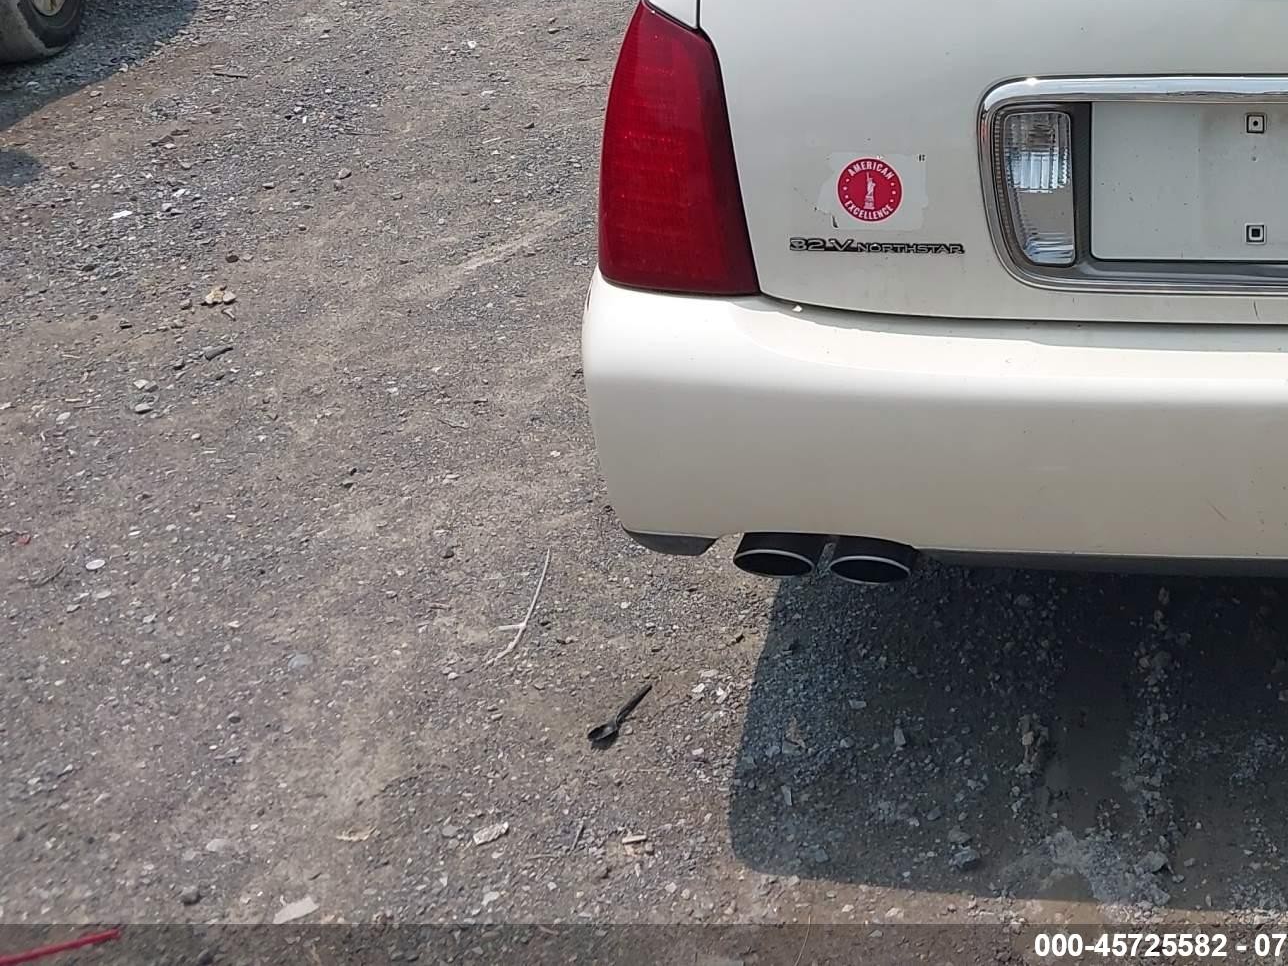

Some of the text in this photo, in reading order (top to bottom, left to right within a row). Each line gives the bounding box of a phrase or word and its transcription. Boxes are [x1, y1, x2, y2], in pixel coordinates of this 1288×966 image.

[849, 161, 894, 181] AMERICAN
[845, 200, 894, 220] EXCELLENCE
[857, 242, 965, 254] NORTHSTAR
